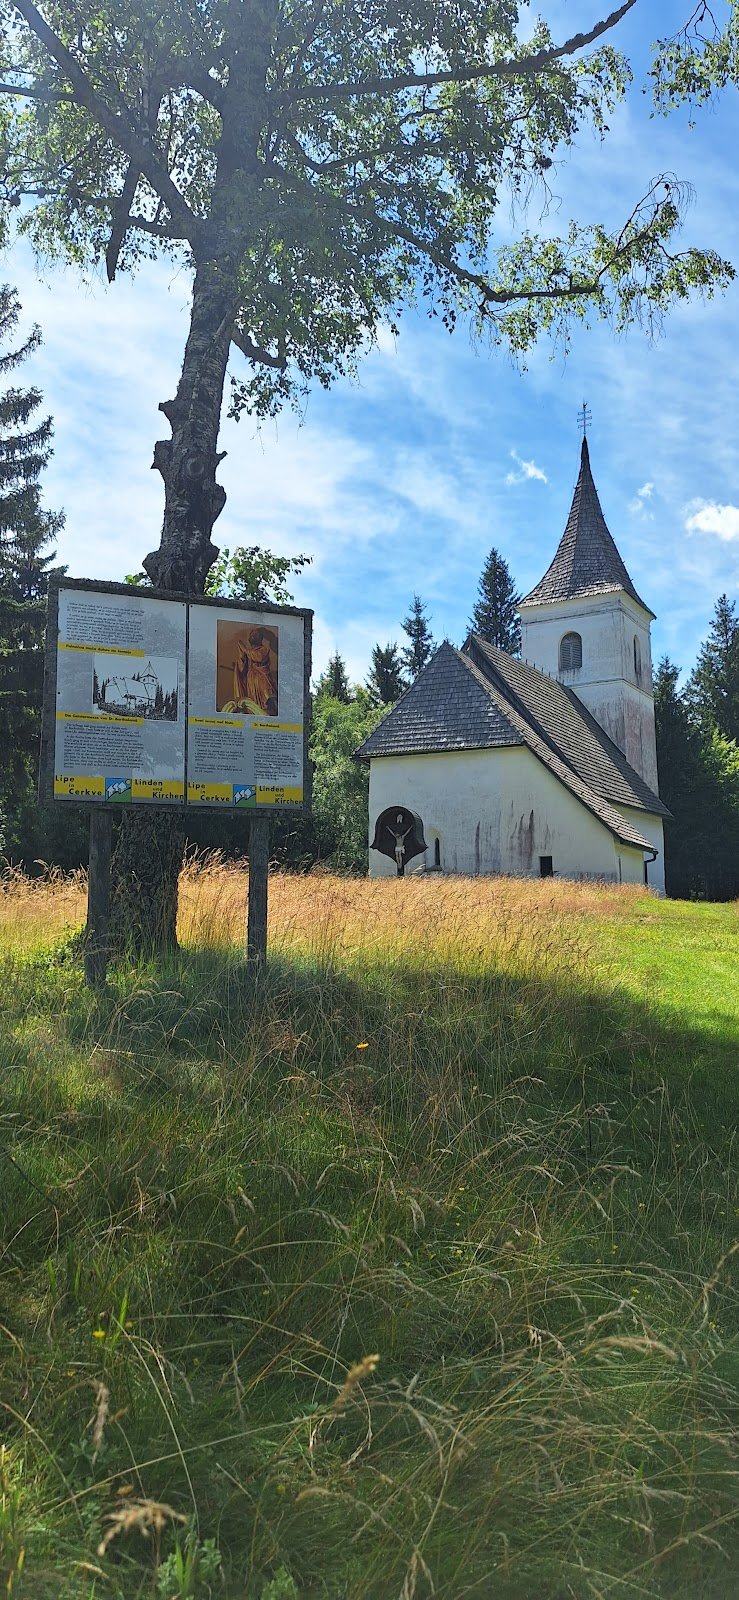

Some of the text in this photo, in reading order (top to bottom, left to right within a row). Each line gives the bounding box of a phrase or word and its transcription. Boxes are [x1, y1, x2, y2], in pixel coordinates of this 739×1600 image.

[55, 774, 75, 783] Lipe
[134, 778, 163, 786] Linden
[188, 782, 206, 790] Lipe
[68, 788, 102, 796] Cerkve
[152, 792, 184, 800] Kirchen
[200, 794, 230, 802] Cerkve
[274, 797, 304, 805] Kirchen
